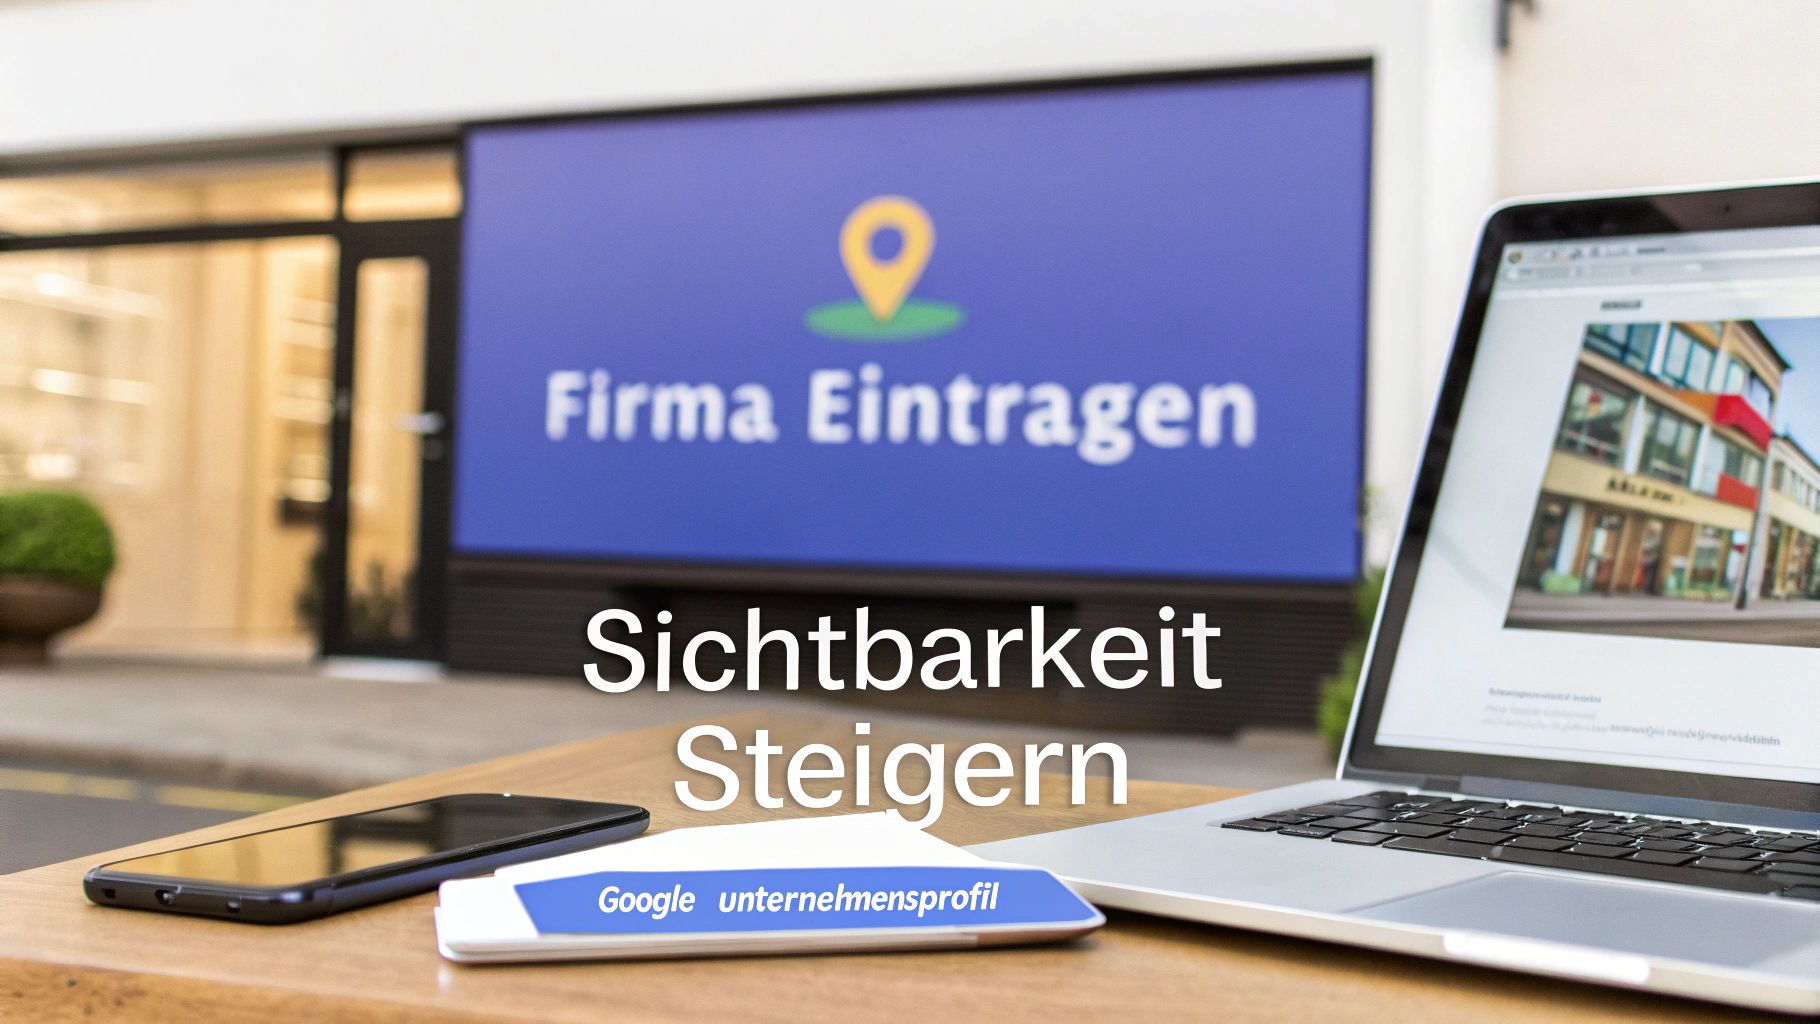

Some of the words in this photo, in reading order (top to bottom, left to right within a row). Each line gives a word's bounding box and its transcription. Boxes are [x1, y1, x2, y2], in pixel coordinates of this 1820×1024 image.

[545, 369, 779, 443] Firma
[807, 363, 1258, 465] Eintragen
[599, 884, 695, 919] Google
[718, 882, 999, 917] unternehmensprofil
